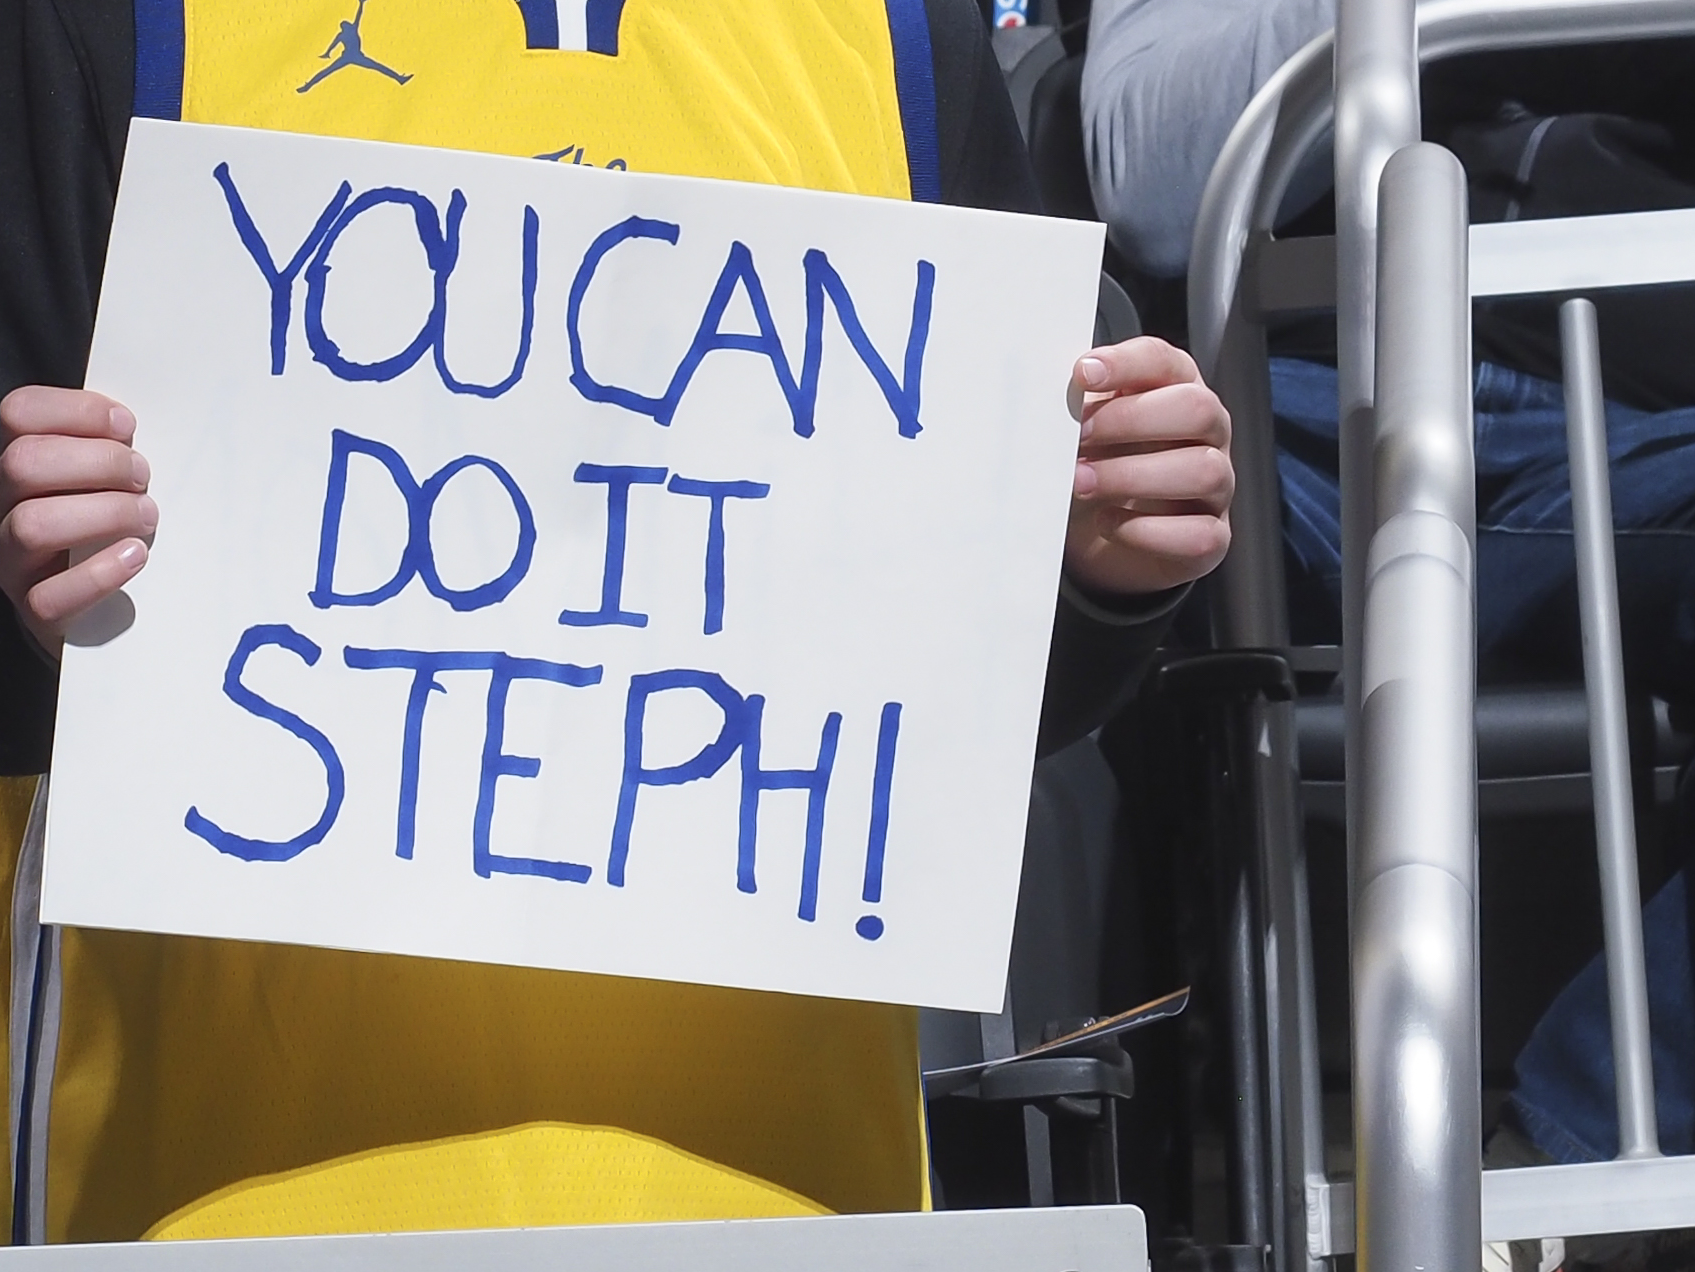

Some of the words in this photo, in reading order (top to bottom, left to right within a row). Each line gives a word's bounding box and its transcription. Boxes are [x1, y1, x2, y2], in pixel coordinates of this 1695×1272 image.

[212, 161, 540, 400] YOU
[566, 215, 937, 439] CAN
[307, 428, 537, 612] DO
[557, 461, 771, 636] IT
[183, 622, 904, 942] STEPH!
